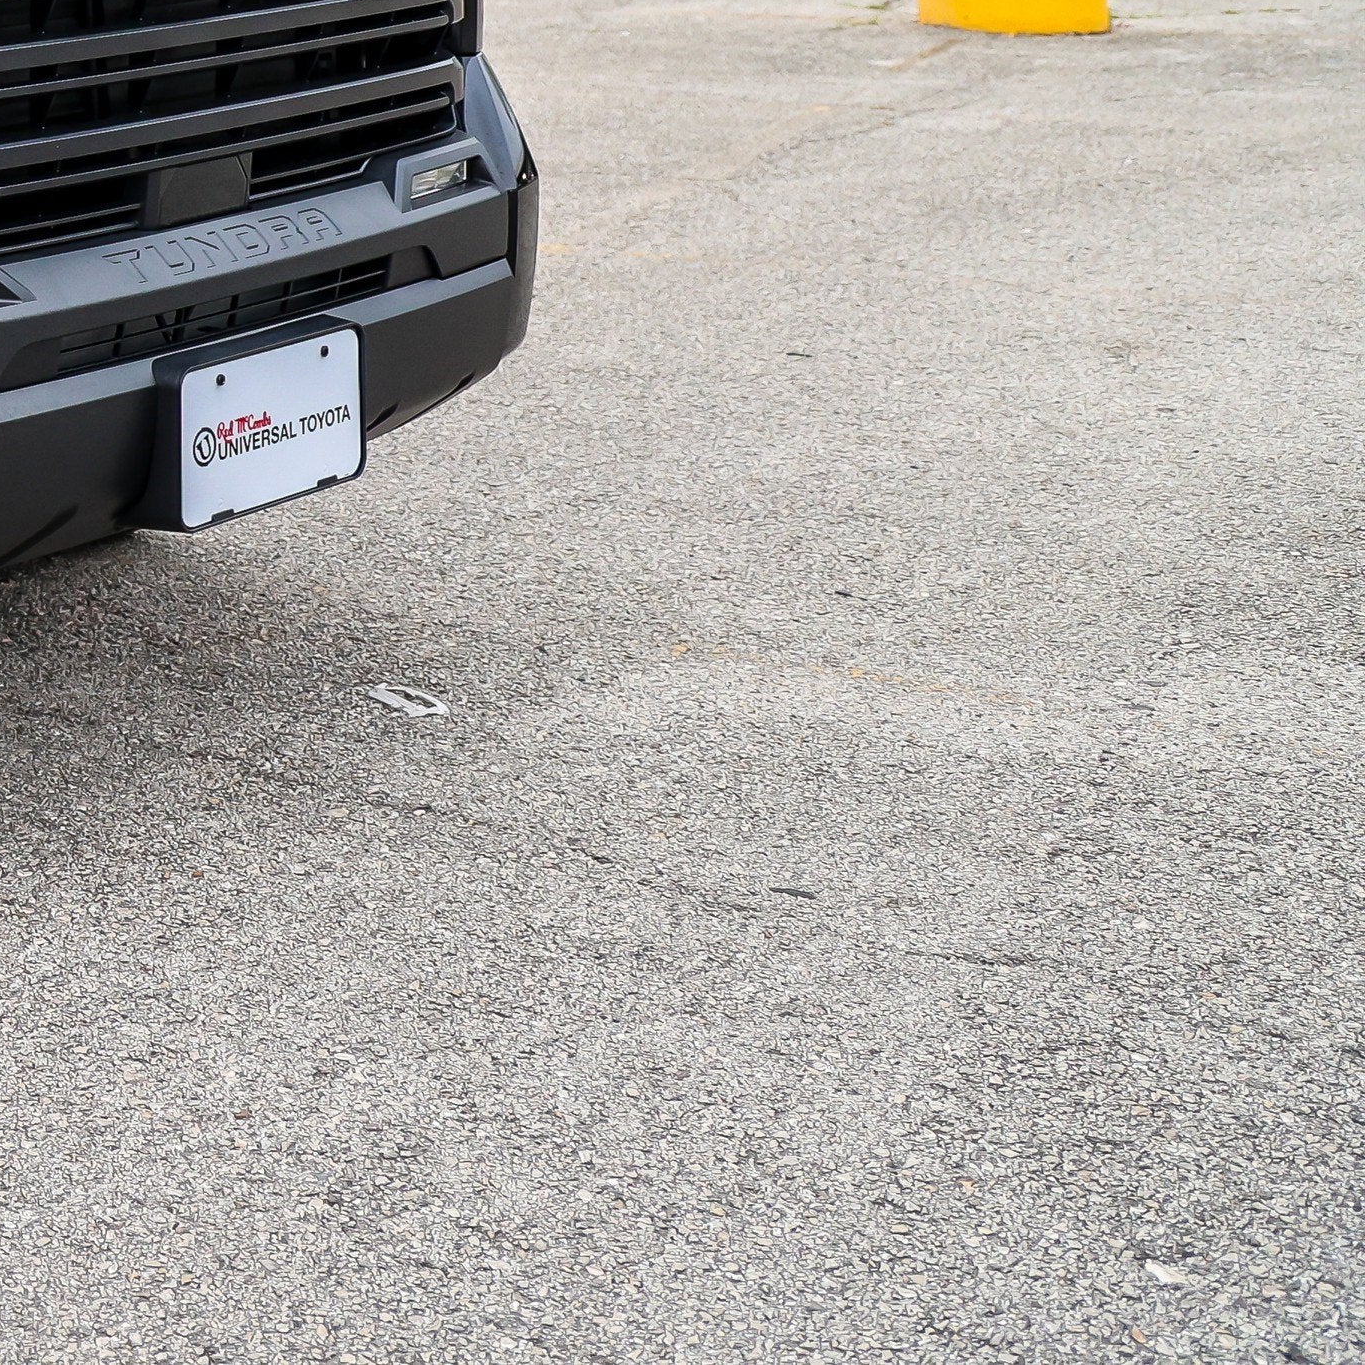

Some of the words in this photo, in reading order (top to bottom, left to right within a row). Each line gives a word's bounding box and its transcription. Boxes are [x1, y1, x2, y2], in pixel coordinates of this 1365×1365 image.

[101, 207, 343, 284] TUNDRA
[217, 420, 234, 443] Red
[218, 421, 297, 460] UNIVERSAL
[298, 404, 351, 435] TOYOTA
